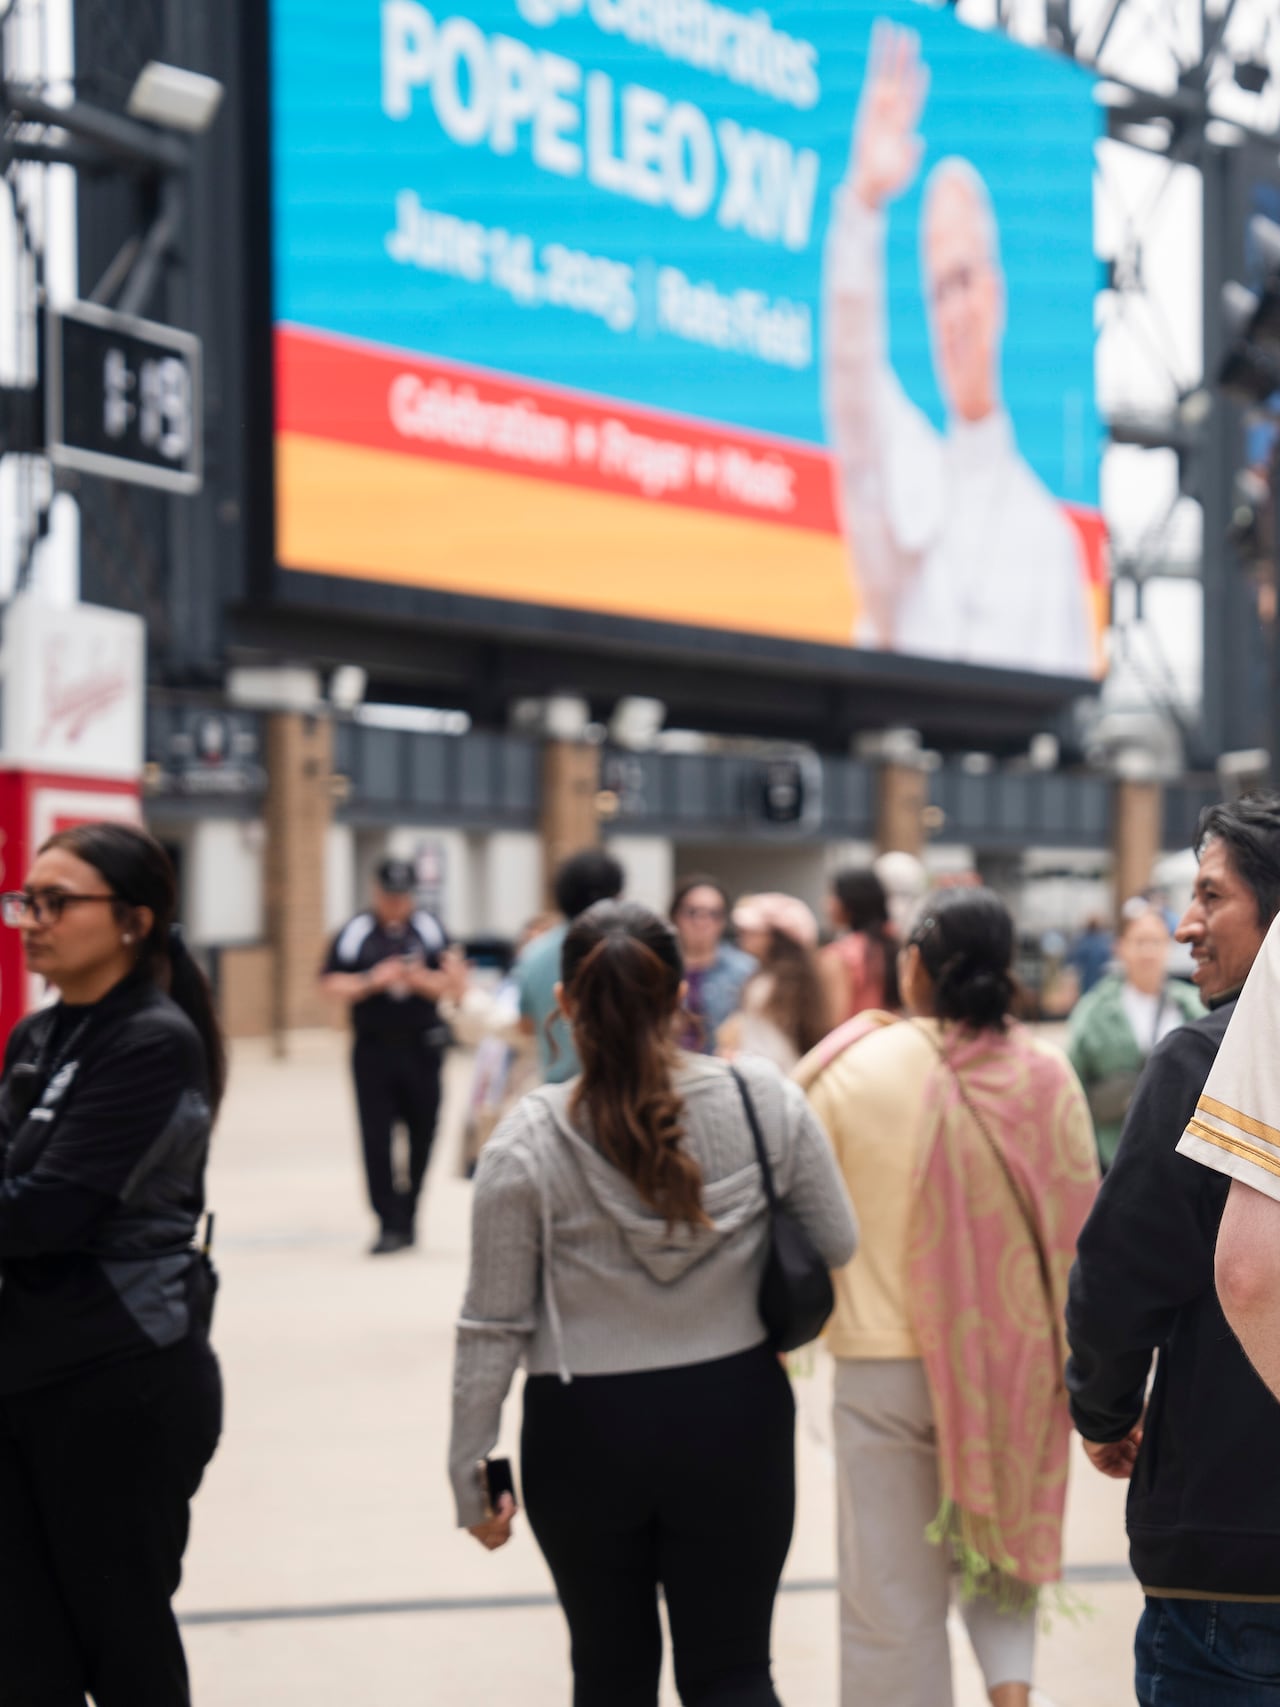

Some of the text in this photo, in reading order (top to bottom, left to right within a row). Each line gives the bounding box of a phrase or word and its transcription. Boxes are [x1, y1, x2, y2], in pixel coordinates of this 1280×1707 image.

[381, 0, 820, 252] POPE LEO XIV
[385, 189, 485, 282] June
[388, 373, 571, 467] Celebration
